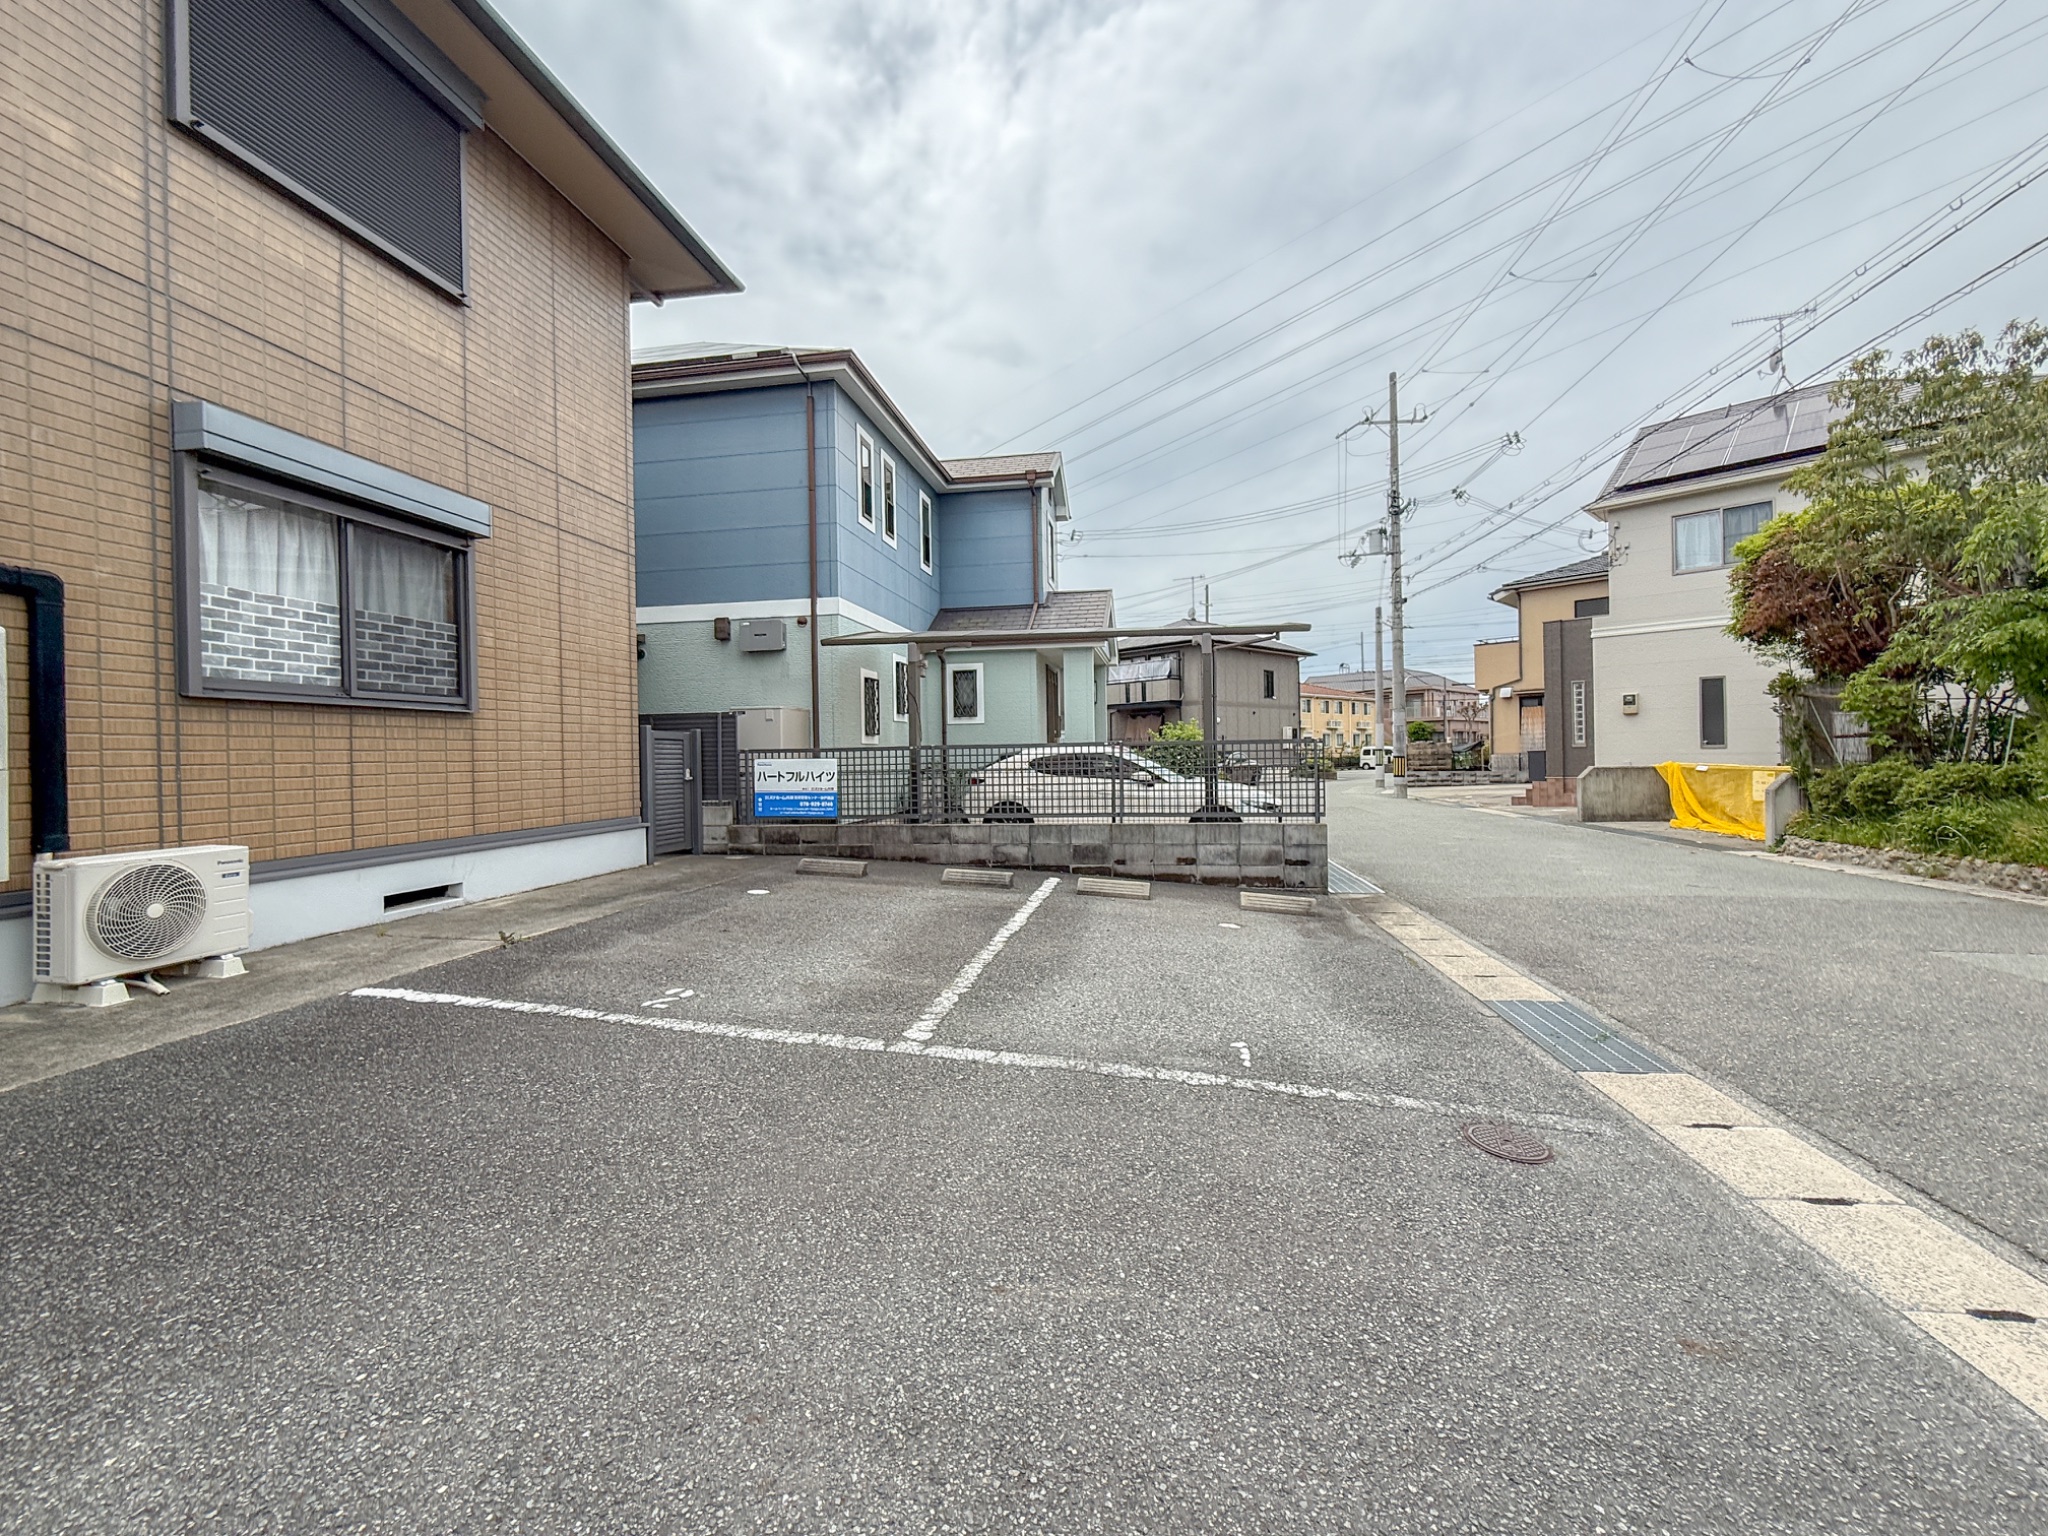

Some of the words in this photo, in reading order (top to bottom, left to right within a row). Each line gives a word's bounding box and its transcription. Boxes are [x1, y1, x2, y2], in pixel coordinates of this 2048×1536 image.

[757, 771, 835, 782] ハートフルハイツ
